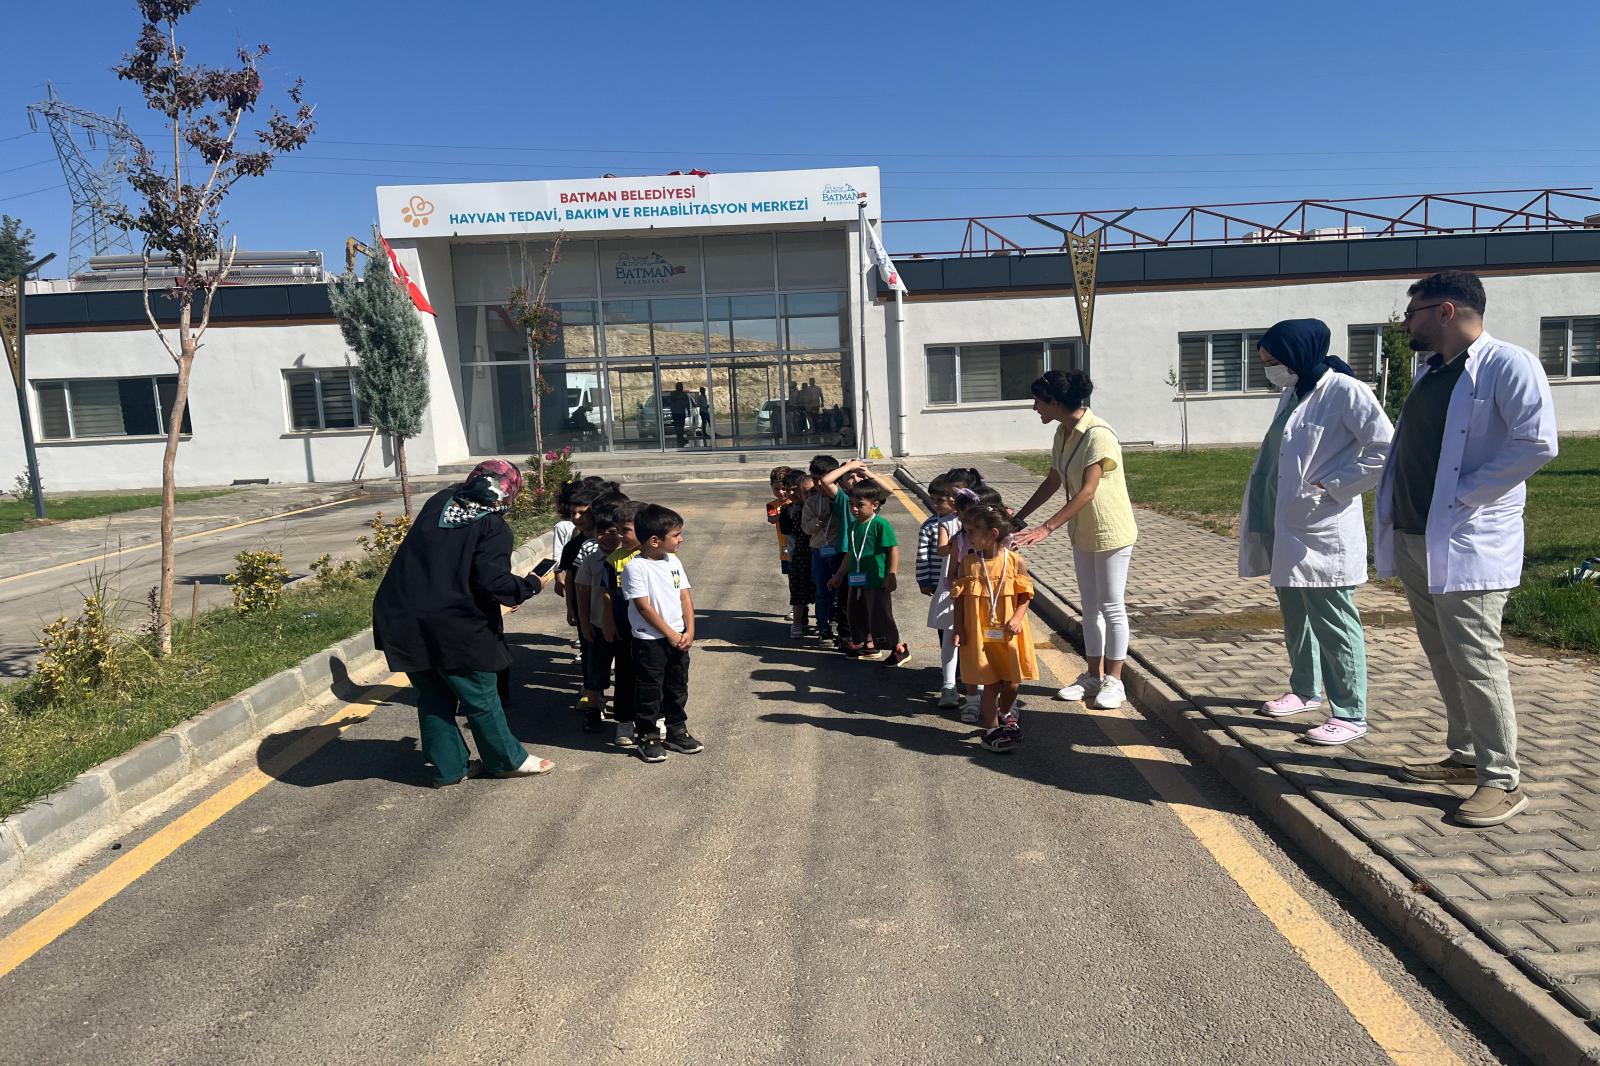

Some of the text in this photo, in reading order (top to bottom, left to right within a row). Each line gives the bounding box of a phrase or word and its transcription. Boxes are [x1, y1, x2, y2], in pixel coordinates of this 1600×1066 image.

[560, 185, 696, 204] BATMAN BELEDİYESİ
[822, 192, 860, 202] BATMAN
[449, 197, 809, 225] HAYVAN TEDAVİ, BAKIM VE REHABİLİTASYON MERKEZİ
[616, 264, 672, 279] BATMAN
